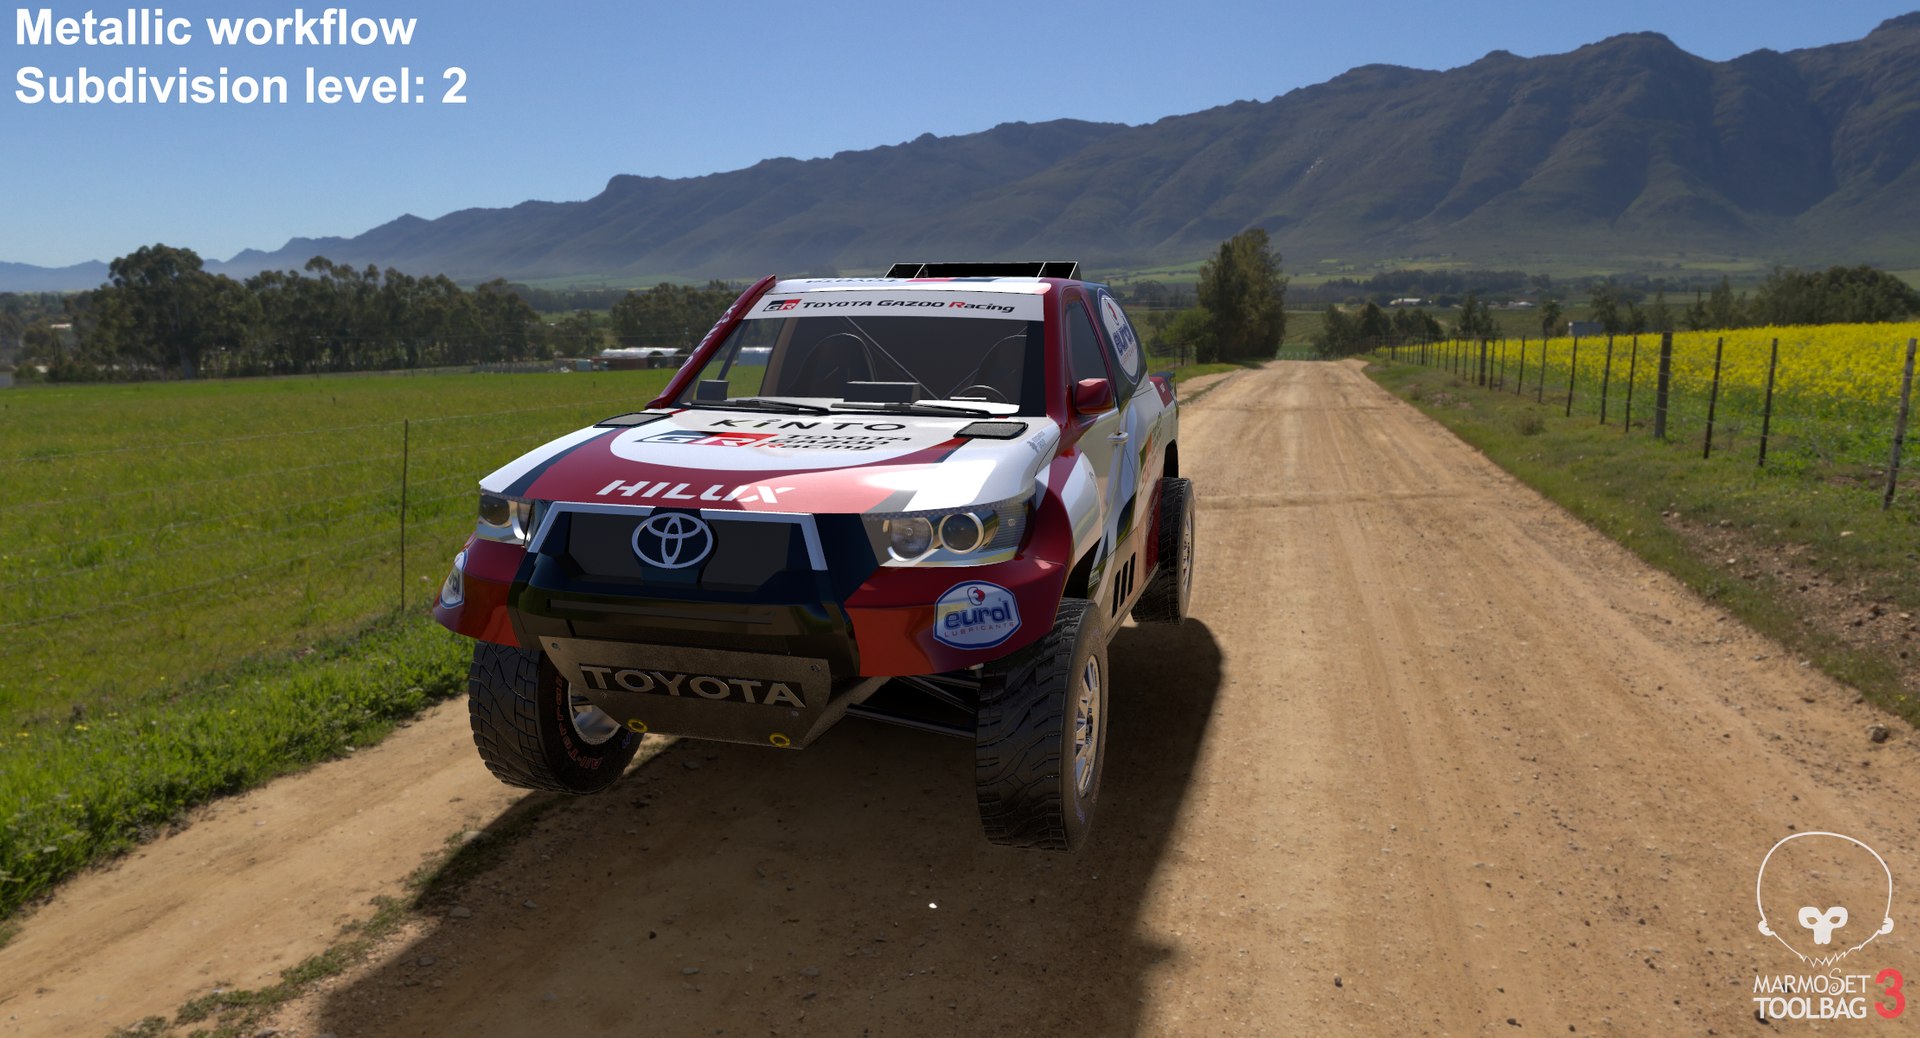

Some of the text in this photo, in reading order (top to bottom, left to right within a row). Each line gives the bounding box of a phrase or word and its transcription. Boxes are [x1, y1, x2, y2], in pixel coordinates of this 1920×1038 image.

[763, 299, 1015, 313] GR TOYOTA GAZOO Racing
[636, 431, 767, 447] GR
[753, 441, 874, 451] Racing
[786, 434, 912, 442] TOYOTA
[595, 479, 797, 504] HILUX
[944, 600, 1013, 630] eurol
[944, 621, 1015, 638] LUBRICANTS
[580, 665, 807, 709] TOYOTA
